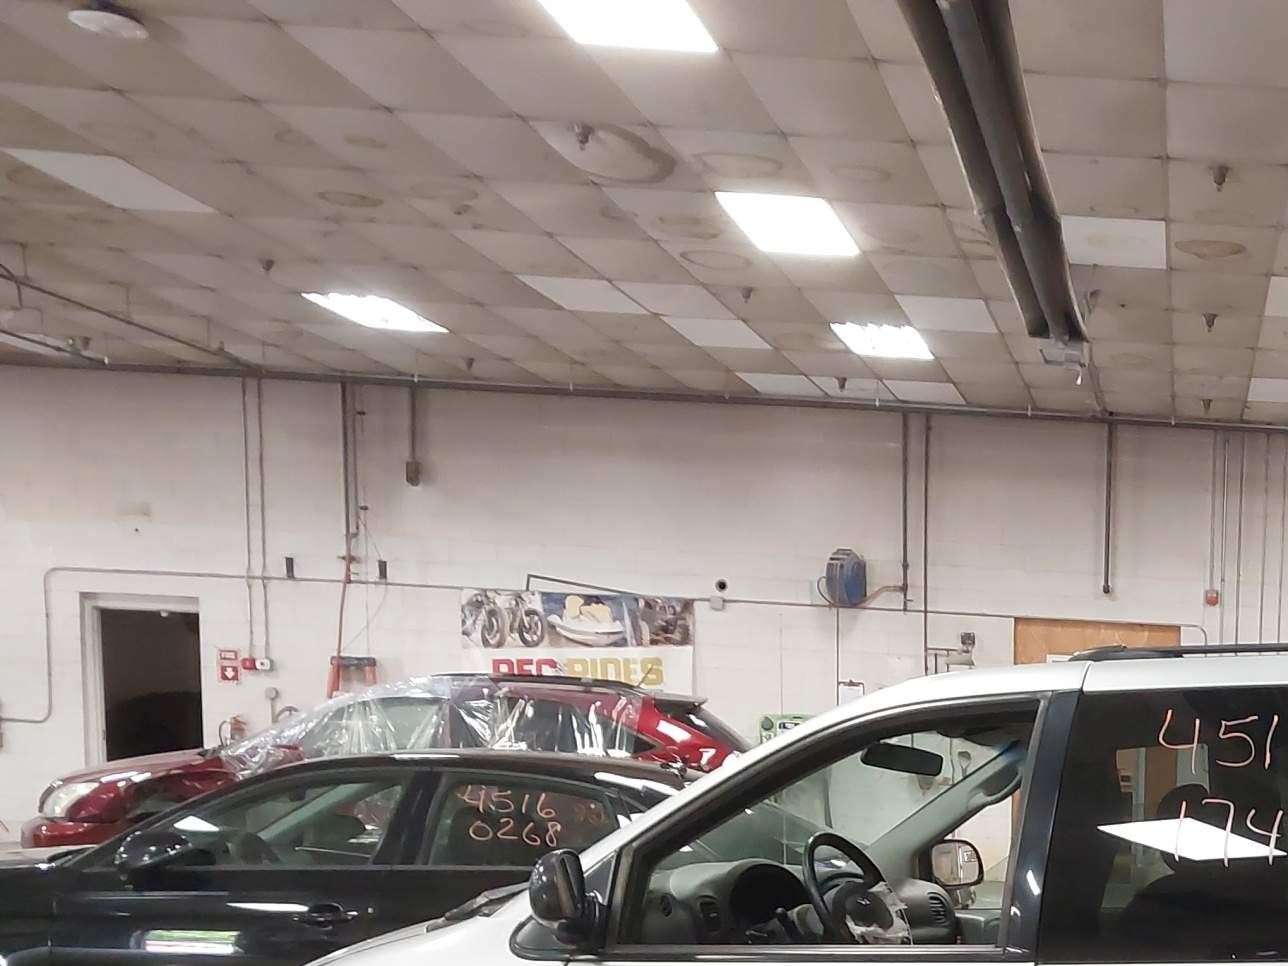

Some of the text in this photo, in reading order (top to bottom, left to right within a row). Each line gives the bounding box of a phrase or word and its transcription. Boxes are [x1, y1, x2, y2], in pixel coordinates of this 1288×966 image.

[566, 656, 664, 686] RIDES
[458, 785, 556, 819] 4516
[468, 817, 562, 848] 0268
